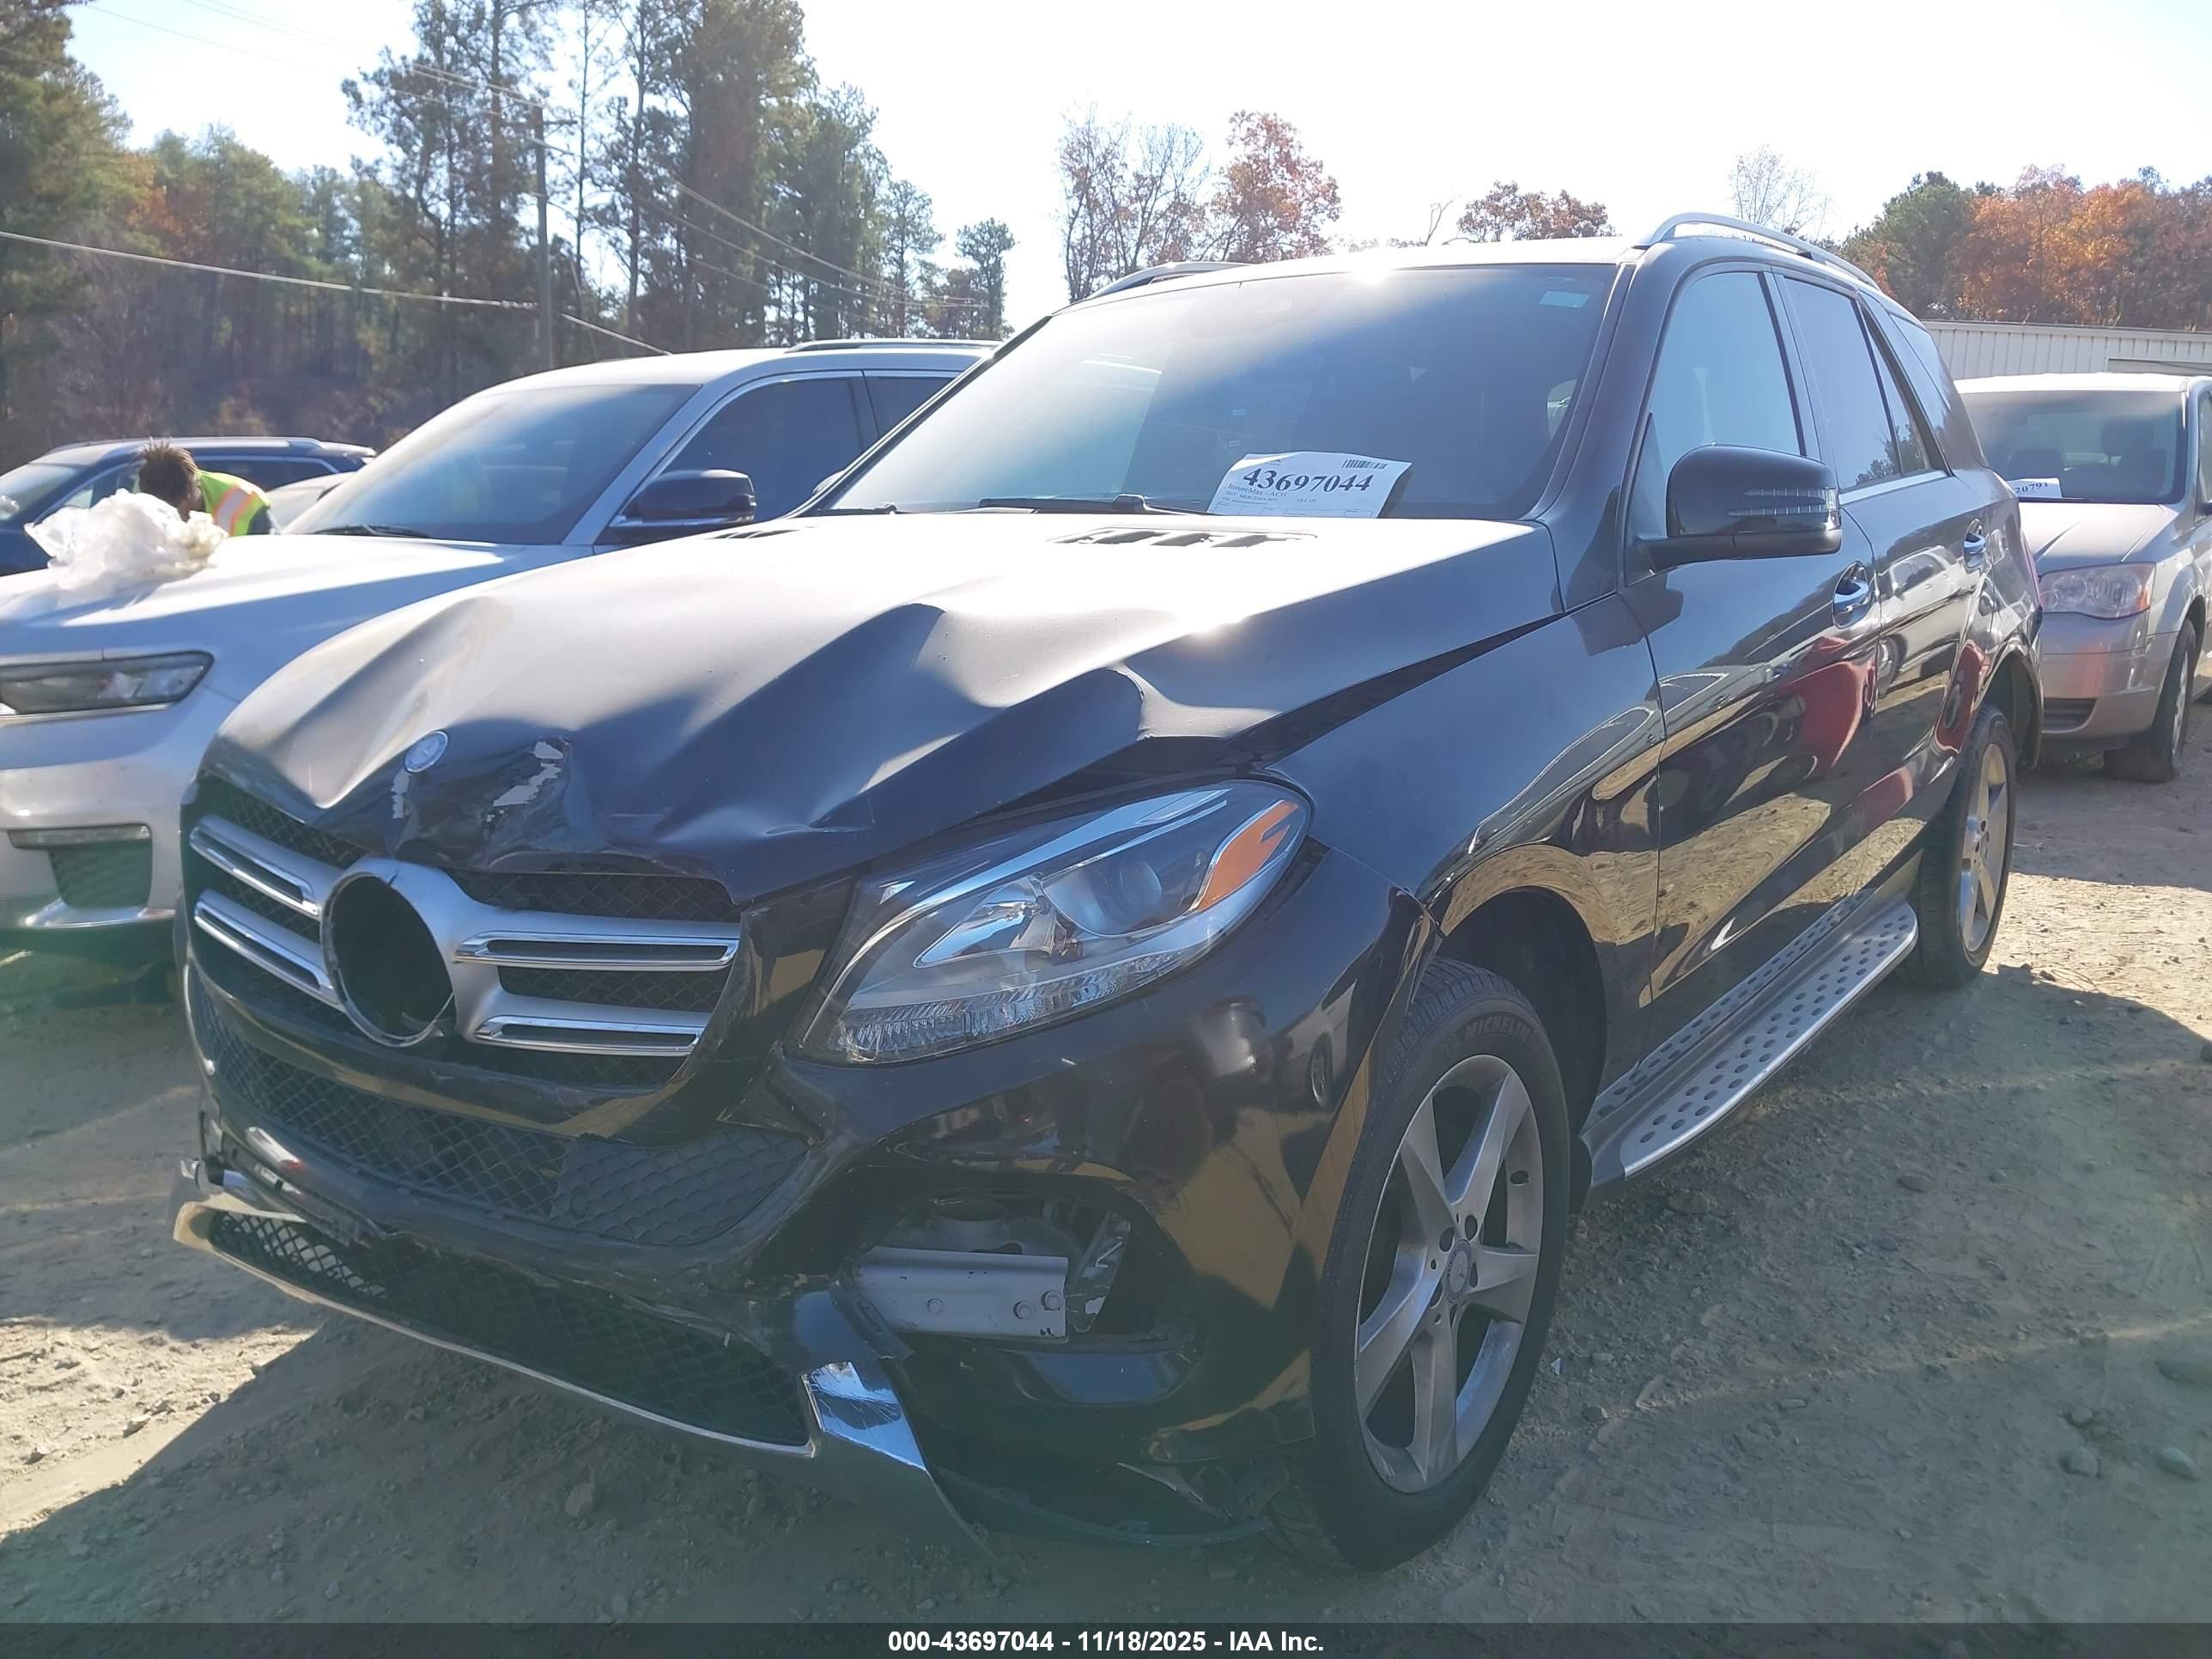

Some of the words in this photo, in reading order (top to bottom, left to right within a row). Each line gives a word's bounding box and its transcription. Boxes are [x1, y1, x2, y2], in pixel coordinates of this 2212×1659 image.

[1228, 483, 1263, 496] InsureMax
[1243, 467, 1374, 493] 43697044
[1464, 1016, 1532, 1043] MICHELIN
